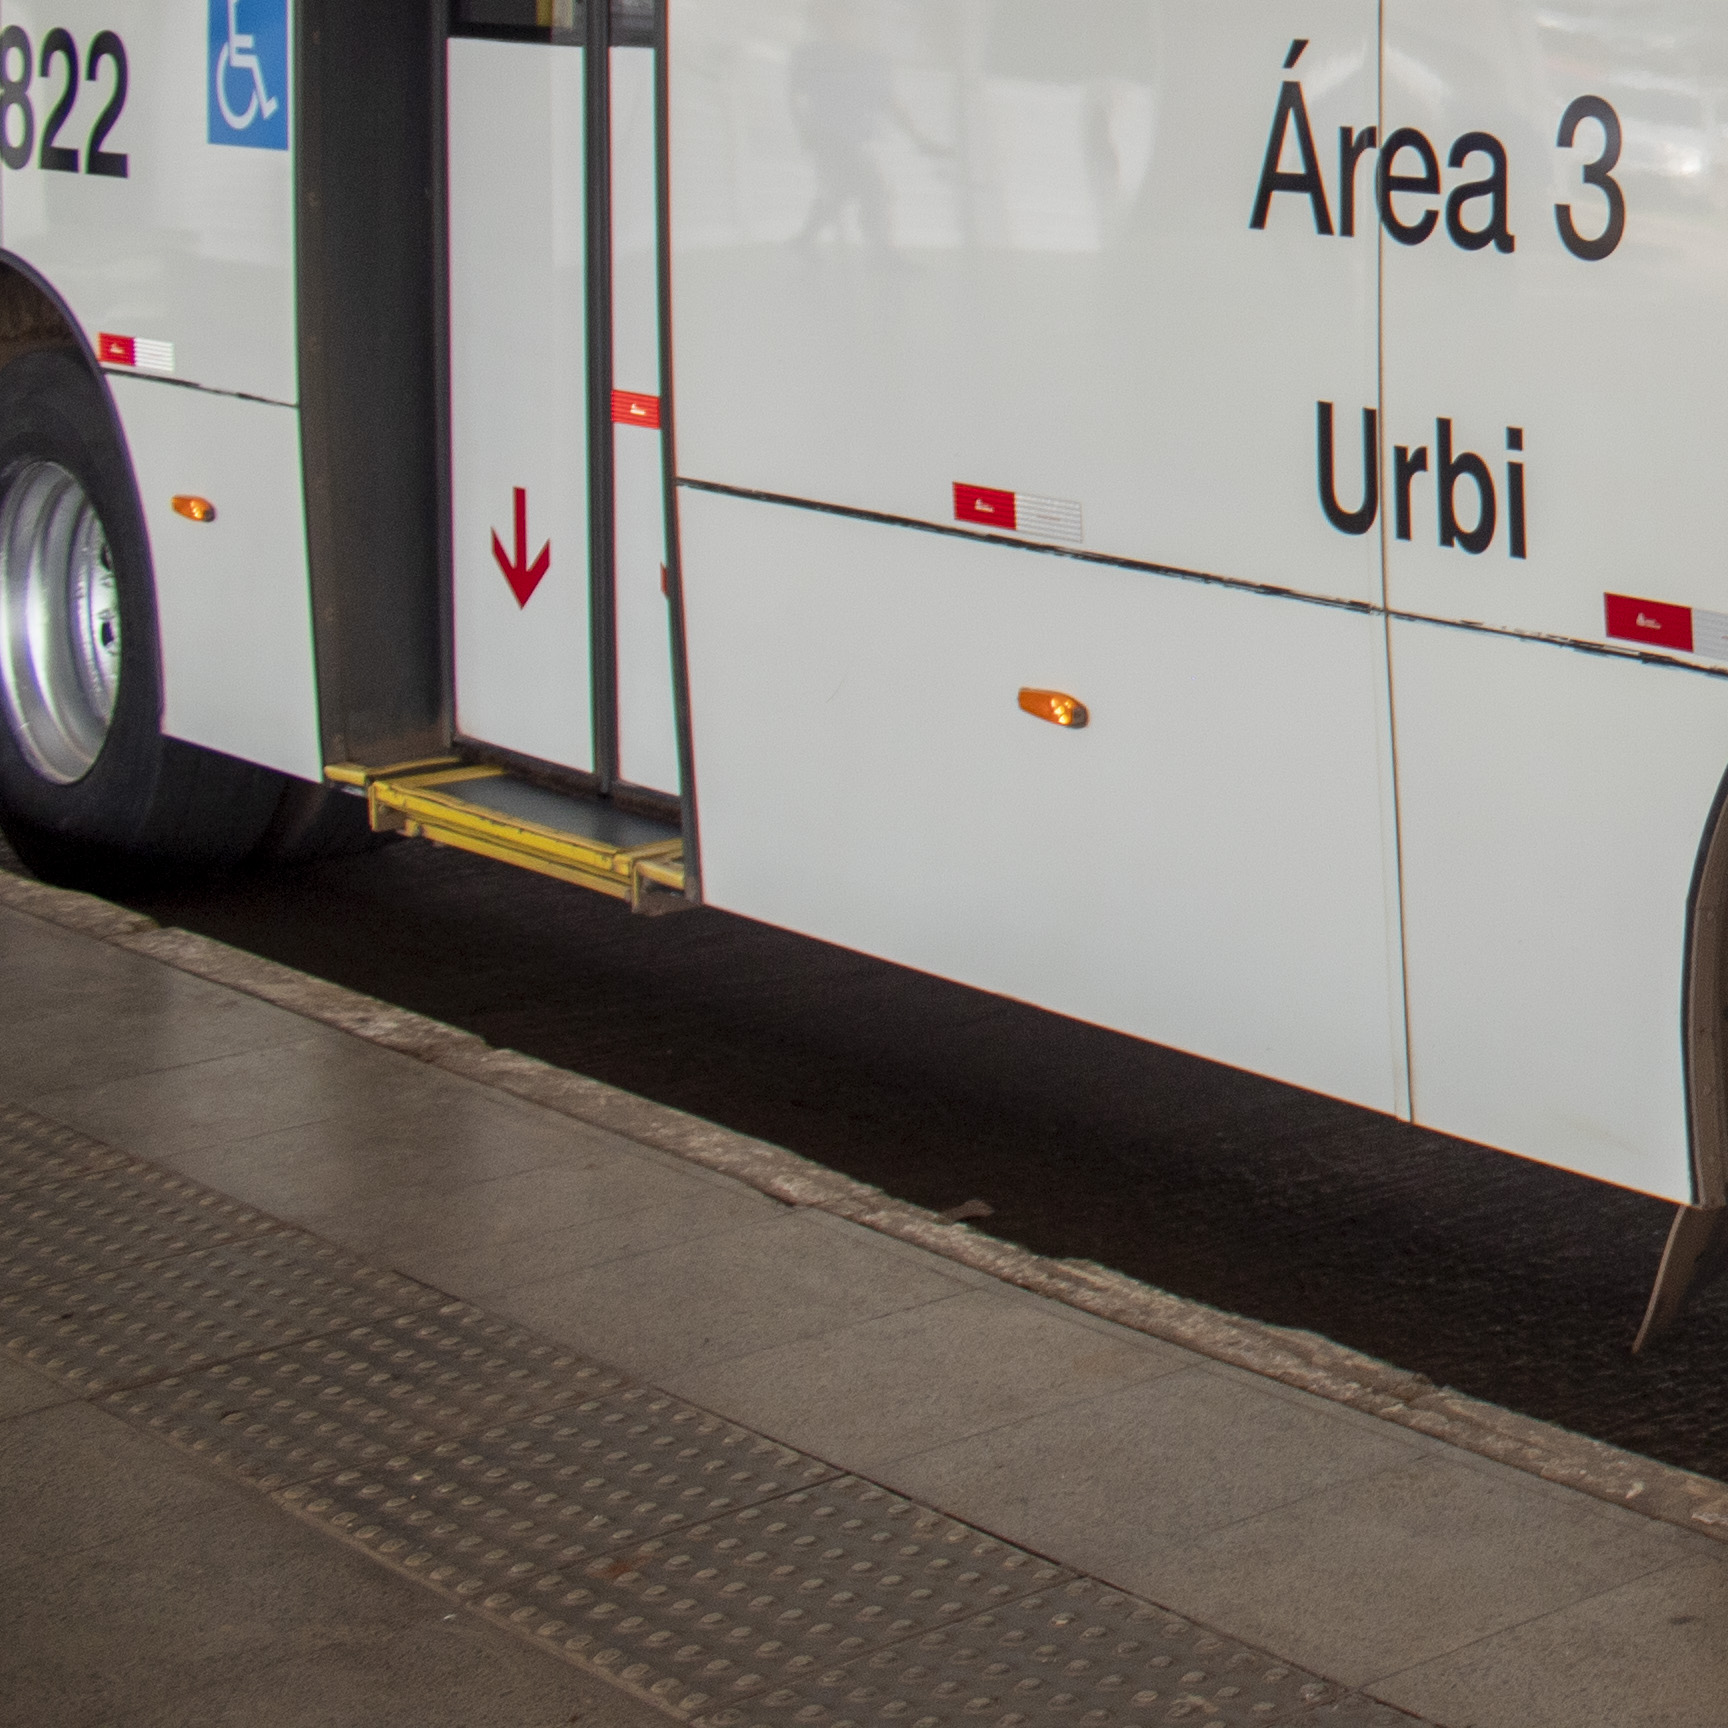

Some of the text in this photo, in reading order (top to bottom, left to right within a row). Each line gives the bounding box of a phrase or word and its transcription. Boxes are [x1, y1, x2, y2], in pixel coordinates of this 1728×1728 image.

[0, 24, 129, 179] 822
[1249, 38, 1627, 262] Área 3
[1316, 399, 1528, 560] Urbi
